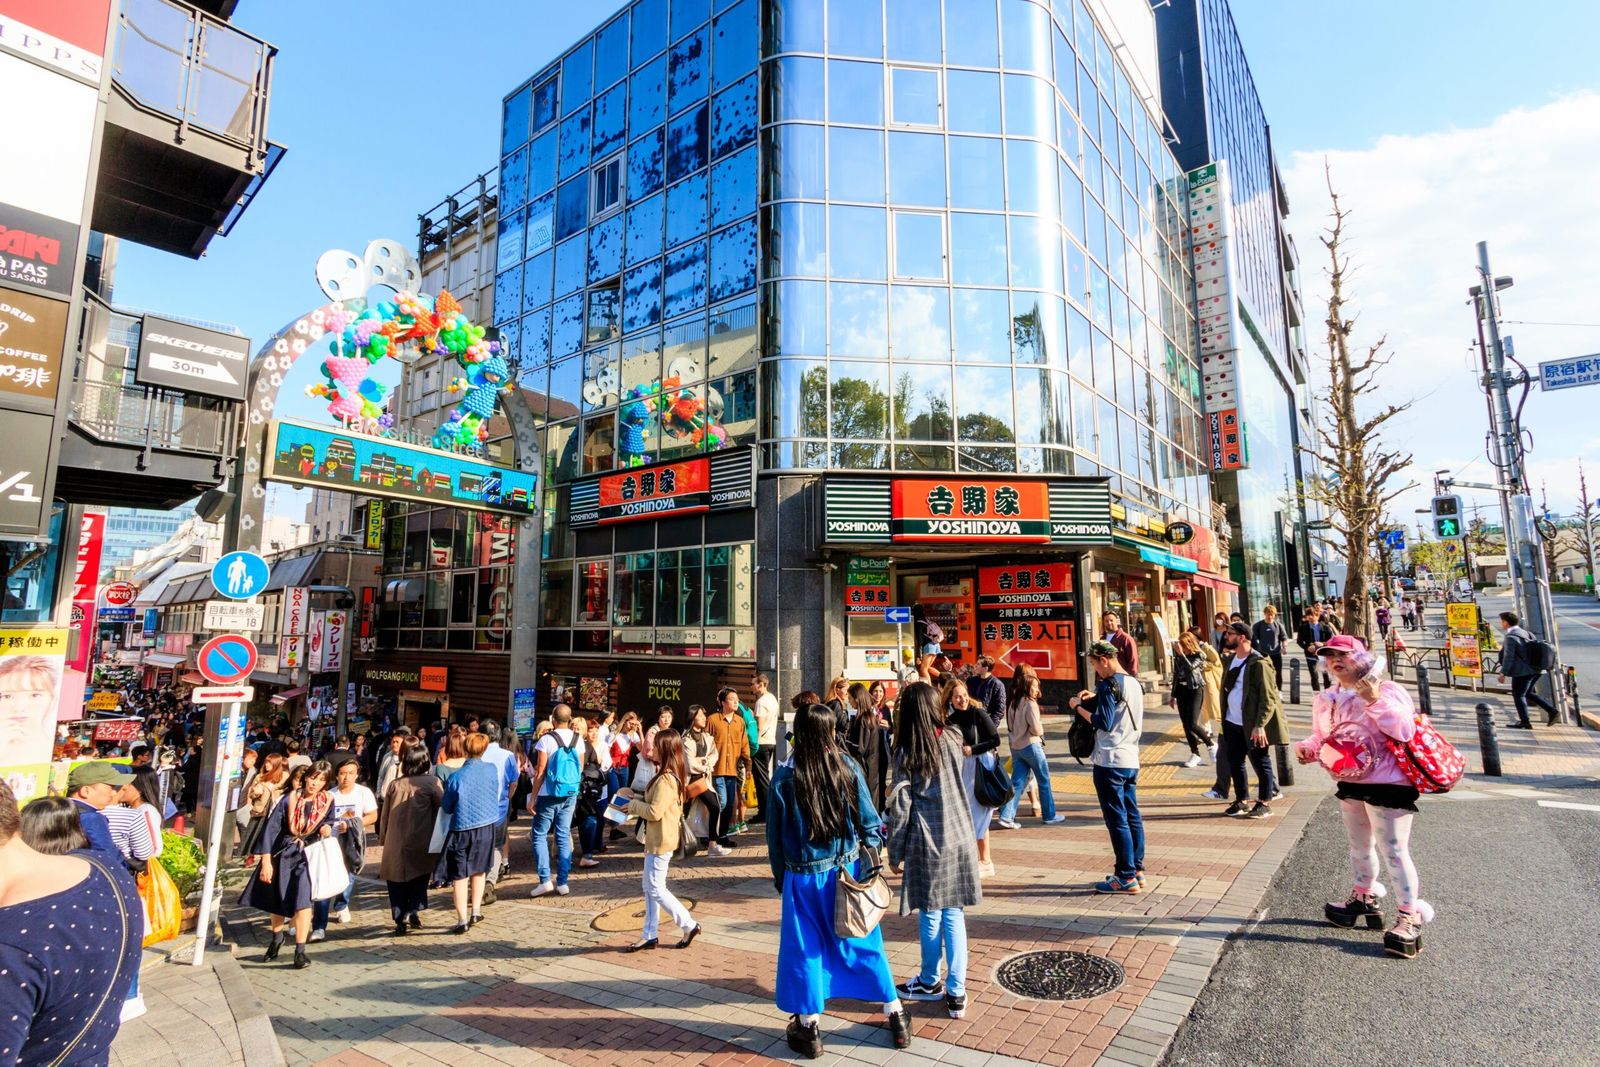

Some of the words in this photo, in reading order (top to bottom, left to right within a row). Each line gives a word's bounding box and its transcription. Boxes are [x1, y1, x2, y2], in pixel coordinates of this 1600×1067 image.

[11, 258, 48, 278] PAS
[11, 271, 47, 285] SASAKI
[0, 303, 36, 324] DRIP
[145, 332, 246, 361] SKECHERS
[172, 360, 205, 375] 30m
[621, 468, 676, 501] 吉野家
[620, 497, 676, 516] YOSHINOYA
[927, 484, 1021, 516] 吉野家
[828, 521, 890, 532] YOSHINOYA
[927, 520, 1022, 534] YOSHINOYA
[1052, 524, 1111, 535] YOSHINOYA
[998, 569, 1052, 590] 吉野家
[293, 588, 303, 606] NOA
[851, 590, 887, 602] 吉野家
[998, 593, 1052, 603] YOSHINOYA
[290, 609, 300, 635] CAFE
[328, 626, 341, 662] クレープ
[366, 670, 400, 680] WOLFGANG
[400, 672, 419, 682] PUCK
[648, 678, 682, 687] WOLFGANG
[648, 686, 681, 701] PUCK
